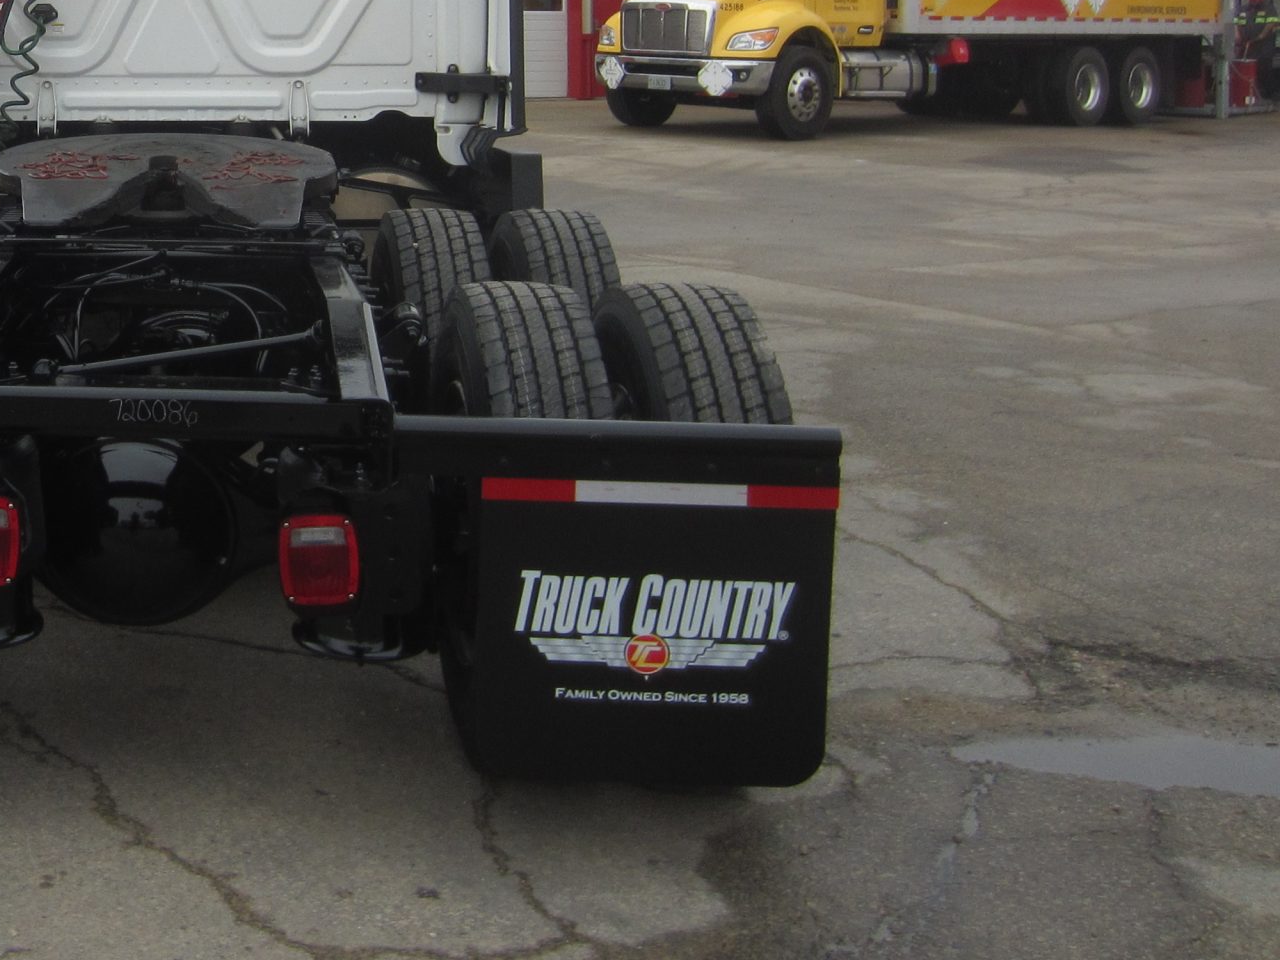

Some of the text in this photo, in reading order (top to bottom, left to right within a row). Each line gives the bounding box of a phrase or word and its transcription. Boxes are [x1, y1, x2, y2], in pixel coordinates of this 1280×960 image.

[109, 398, 198, 427] 720086
[514, 569, 796, 639] TRUCK COUNTRY
[555, 687, 750, 704] FAMILY OWNED SINCE 1958
